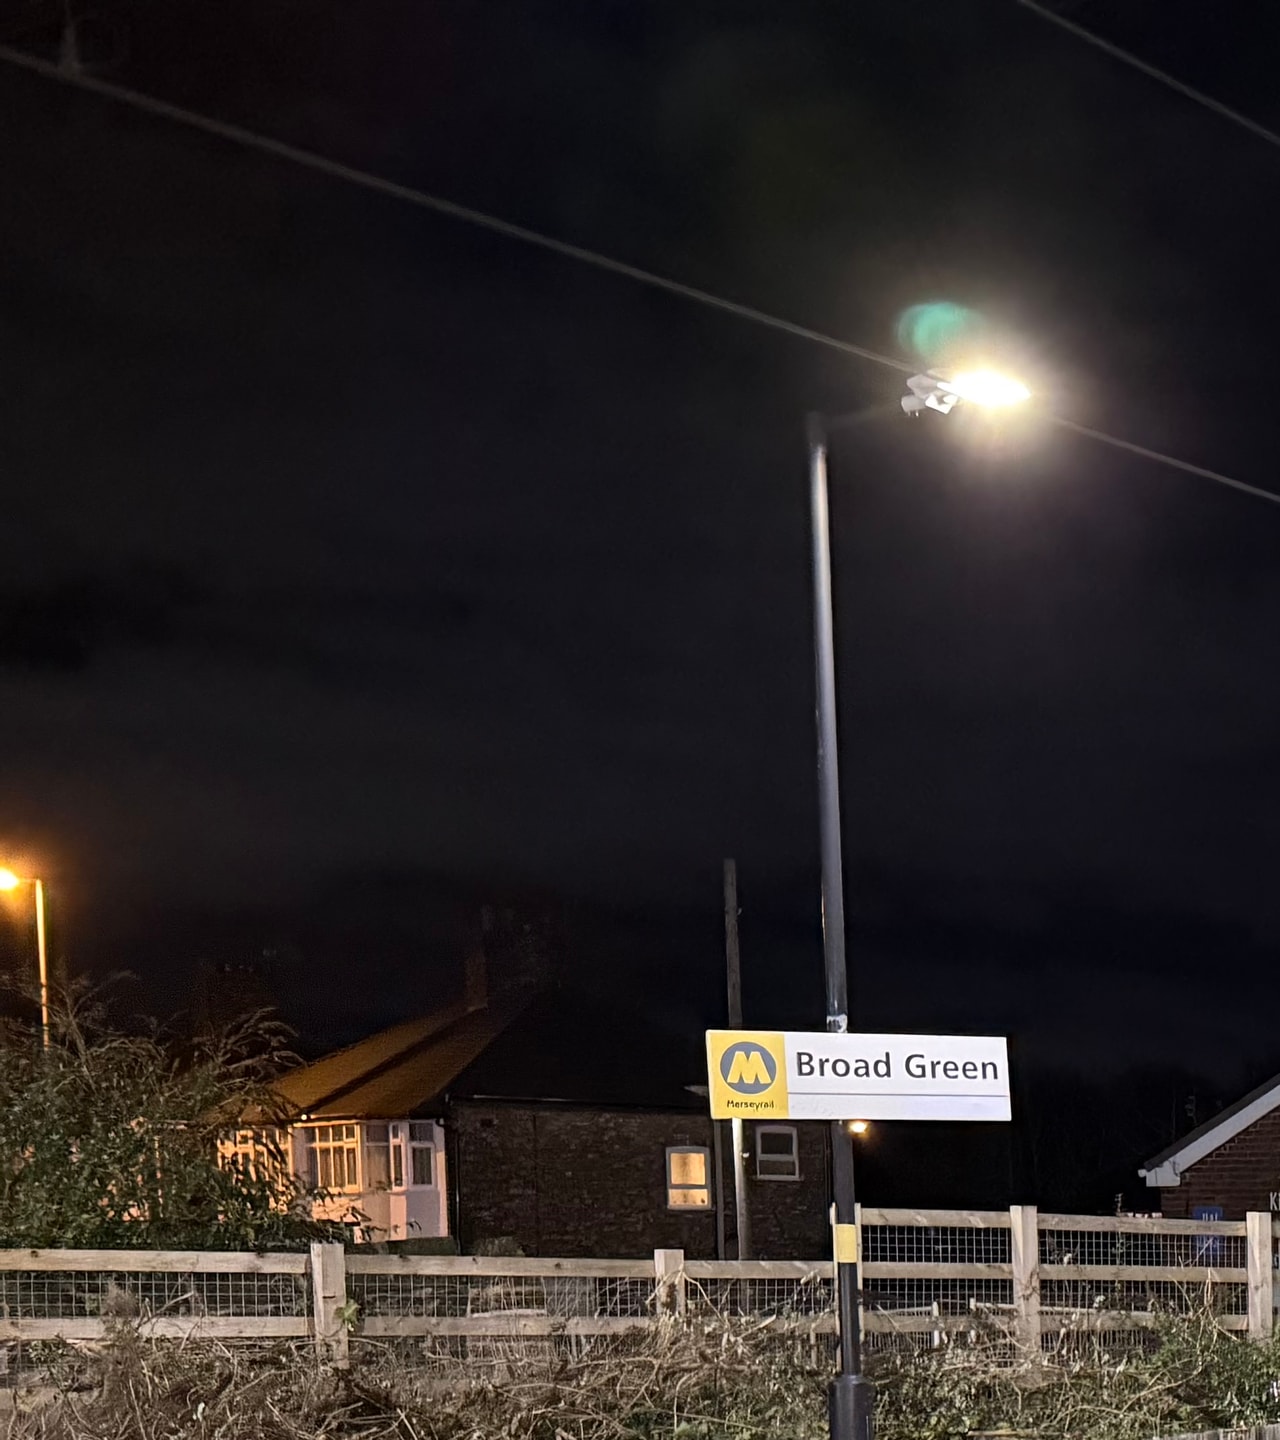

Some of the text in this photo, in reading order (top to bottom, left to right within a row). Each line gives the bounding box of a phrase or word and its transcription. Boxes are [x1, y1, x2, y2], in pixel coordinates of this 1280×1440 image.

[797, 1051, 999, 1080] Broad Green
[727, 1099, 774, 1112] Merseyrail
